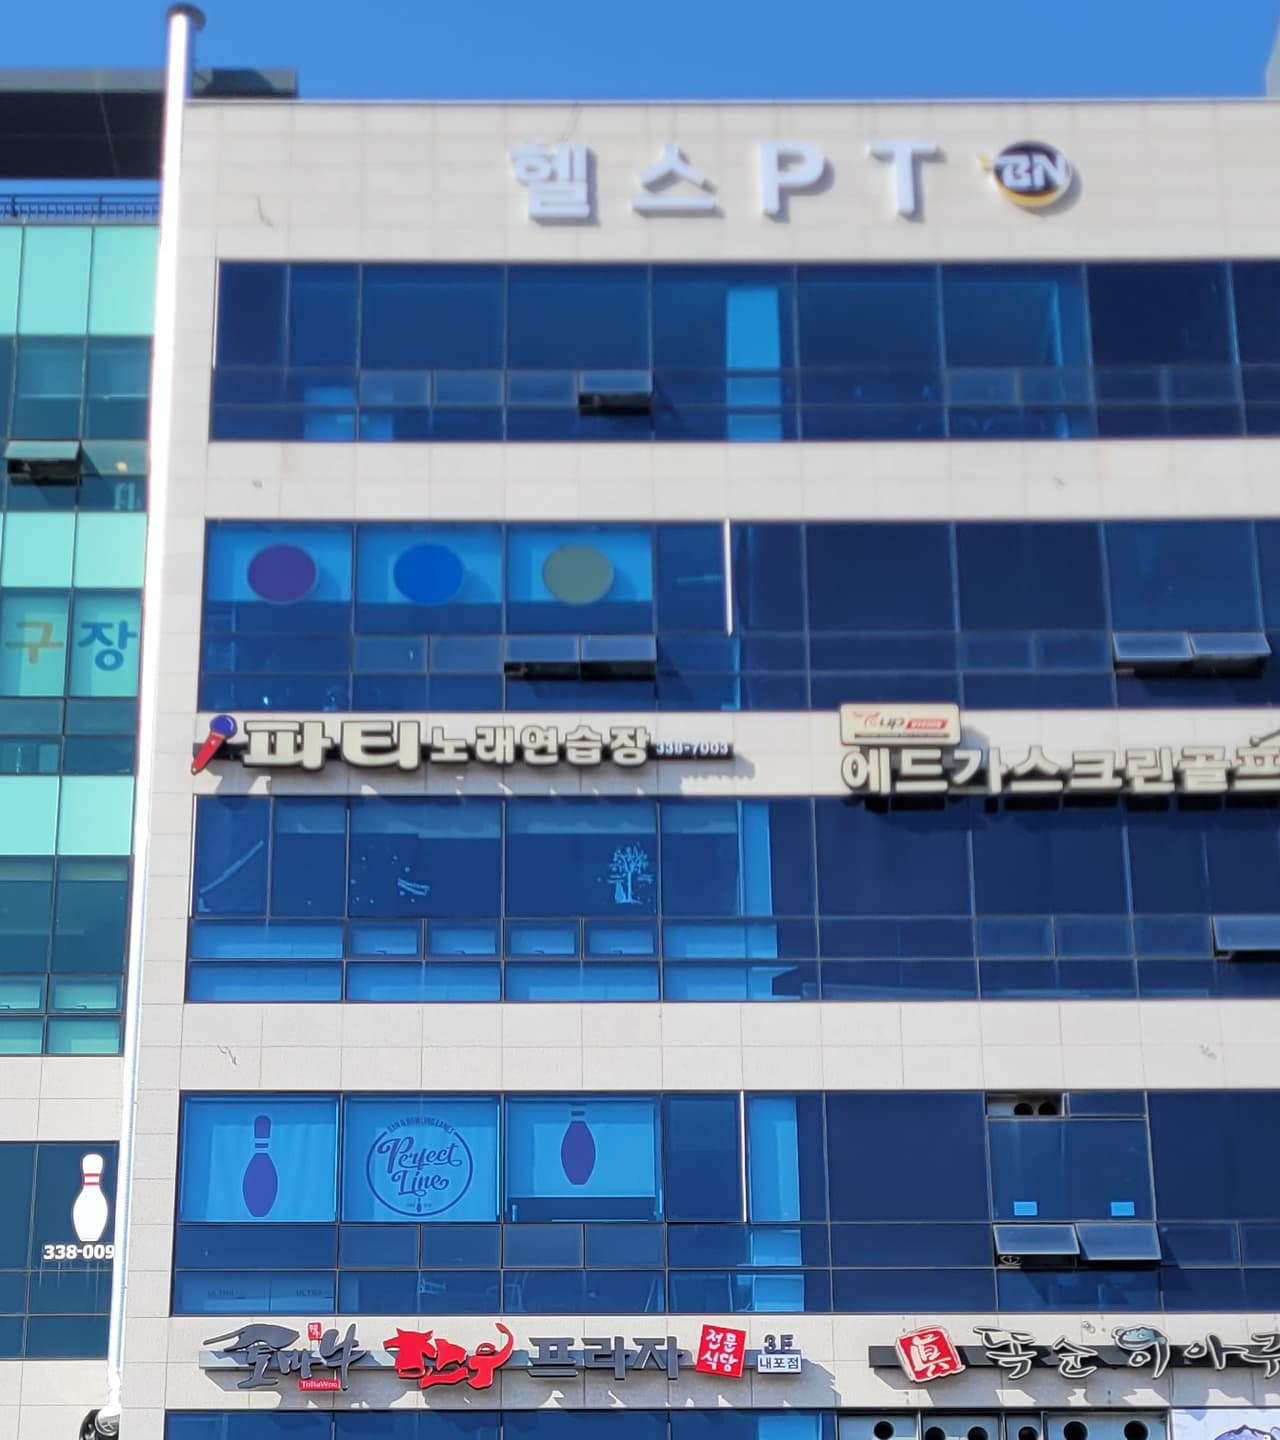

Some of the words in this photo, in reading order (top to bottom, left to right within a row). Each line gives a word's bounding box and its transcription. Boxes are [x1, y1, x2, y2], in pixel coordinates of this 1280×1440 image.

[429, 724, 652, 767] 노래연습장
[377, 1136, 463, 1174] Perfect
[391, 1169, 450, 1197] Line
[43, 1244, 117, 1261] 338-009
[705, 1329, 738, 1353] 전문
[763, 1333, 794, 1354] 3F
[526, 1336, 680, 1380] 프라자
[700, 1350, 739, 1372] 식당
[759, 1357, 800, 1370] 내포점
